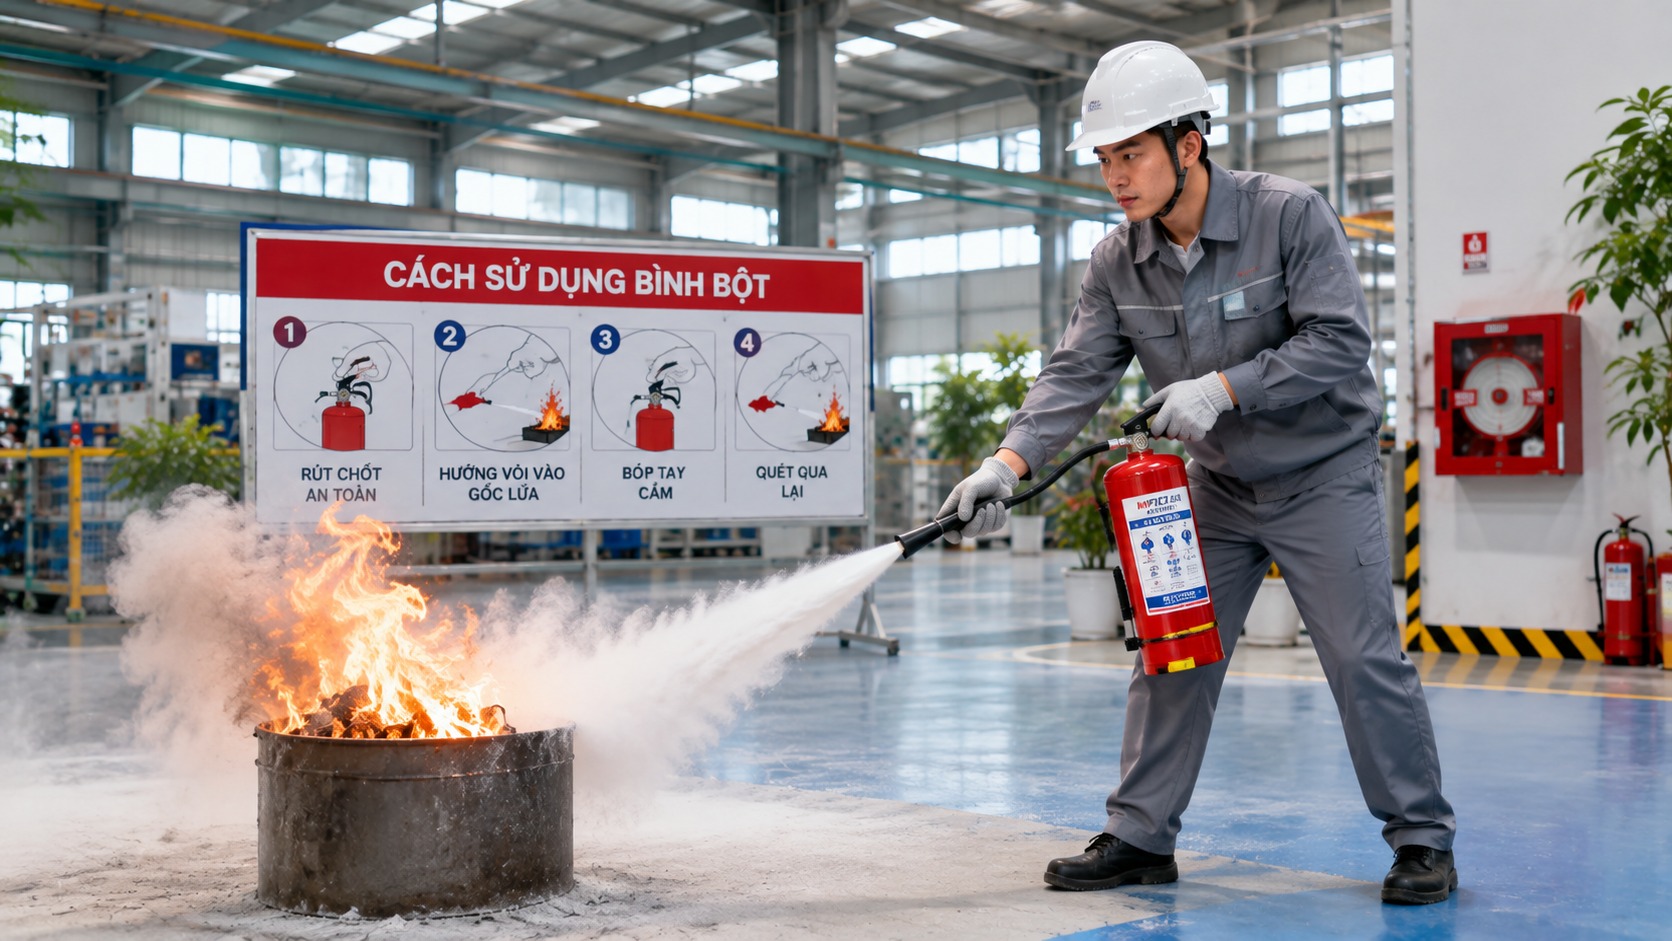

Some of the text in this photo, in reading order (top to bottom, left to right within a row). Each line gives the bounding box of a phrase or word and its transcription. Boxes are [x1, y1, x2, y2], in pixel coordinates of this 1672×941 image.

[383, 254, 771, 304] CÁCH SỬ DỤNG BÌNH BỘT
[283, 322, 295, 342] 1
[442, 326, 458, 347] 2
[598, 329, 613, 350] 3
[740, 333, 755, 352] 4
[301, 462, 383, 481] RÚT CHỐT
[439, 463, 498, 480] HƯỚNG
[533, 463, 565, 480] VÀO
[622, 462, 686, 480] BÓP TAY
[756, 462, 828, 481] QUÉT QUA
[305, 487, 328, 502] AN
[781, 484, 804, 501] LẠI
